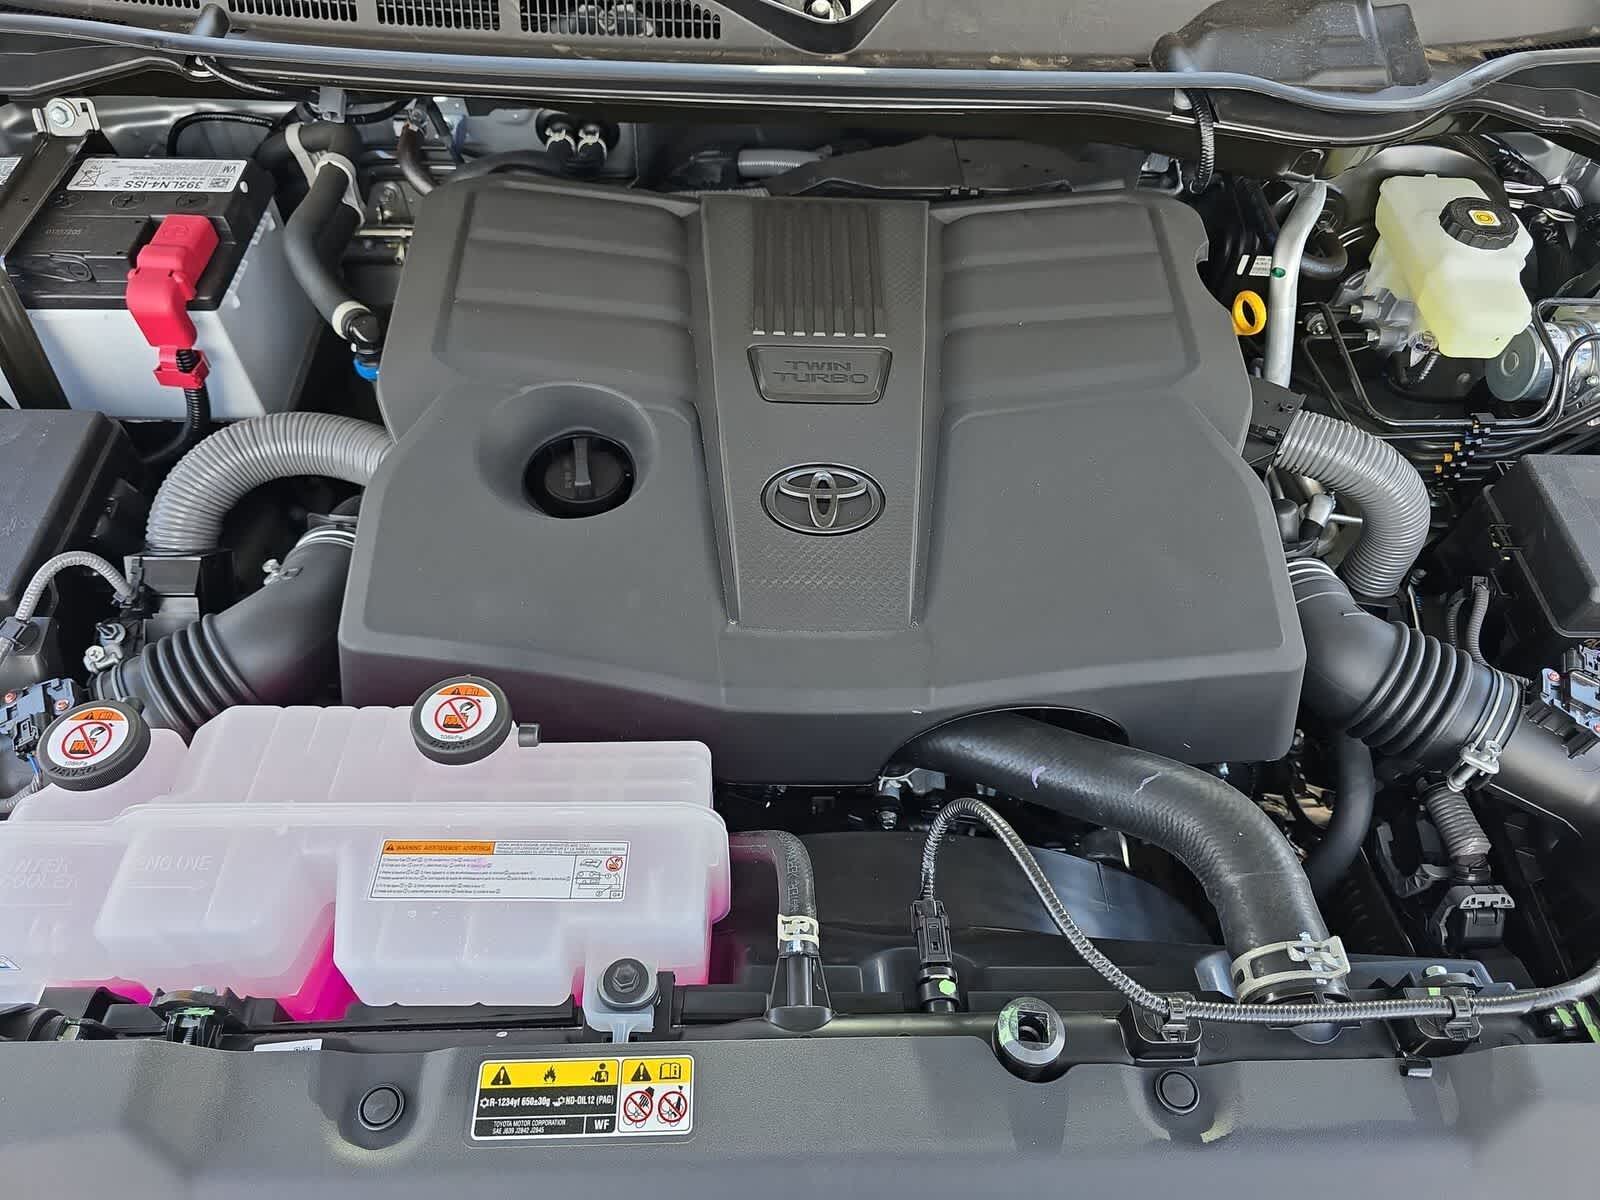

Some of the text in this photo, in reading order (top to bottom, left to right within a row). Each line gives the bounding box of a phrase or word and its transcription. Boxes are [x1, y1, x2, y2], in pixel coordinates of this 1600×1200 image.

[223, 165, 237, 174] VM
[123, 180, 204, 190] 395LN4-ISS
[783, 360, 852, 372] TWIN
[771, 371, 869, 384] TURBO
[49, 765, 98, 777] DENSO
[489, 1097, 520, 1109] R-1234yf
[521, 1096, 551, 1107] 650±30g
[596, 1094, 614, 1106] (PAG)
[493, 1120, 513, 1128] TOYOTA
[531, 1118, 567, 1127] CORPORATION
[594, 1119, 610, 1131] WF
[492, 1127, 502, 1135] SAE
